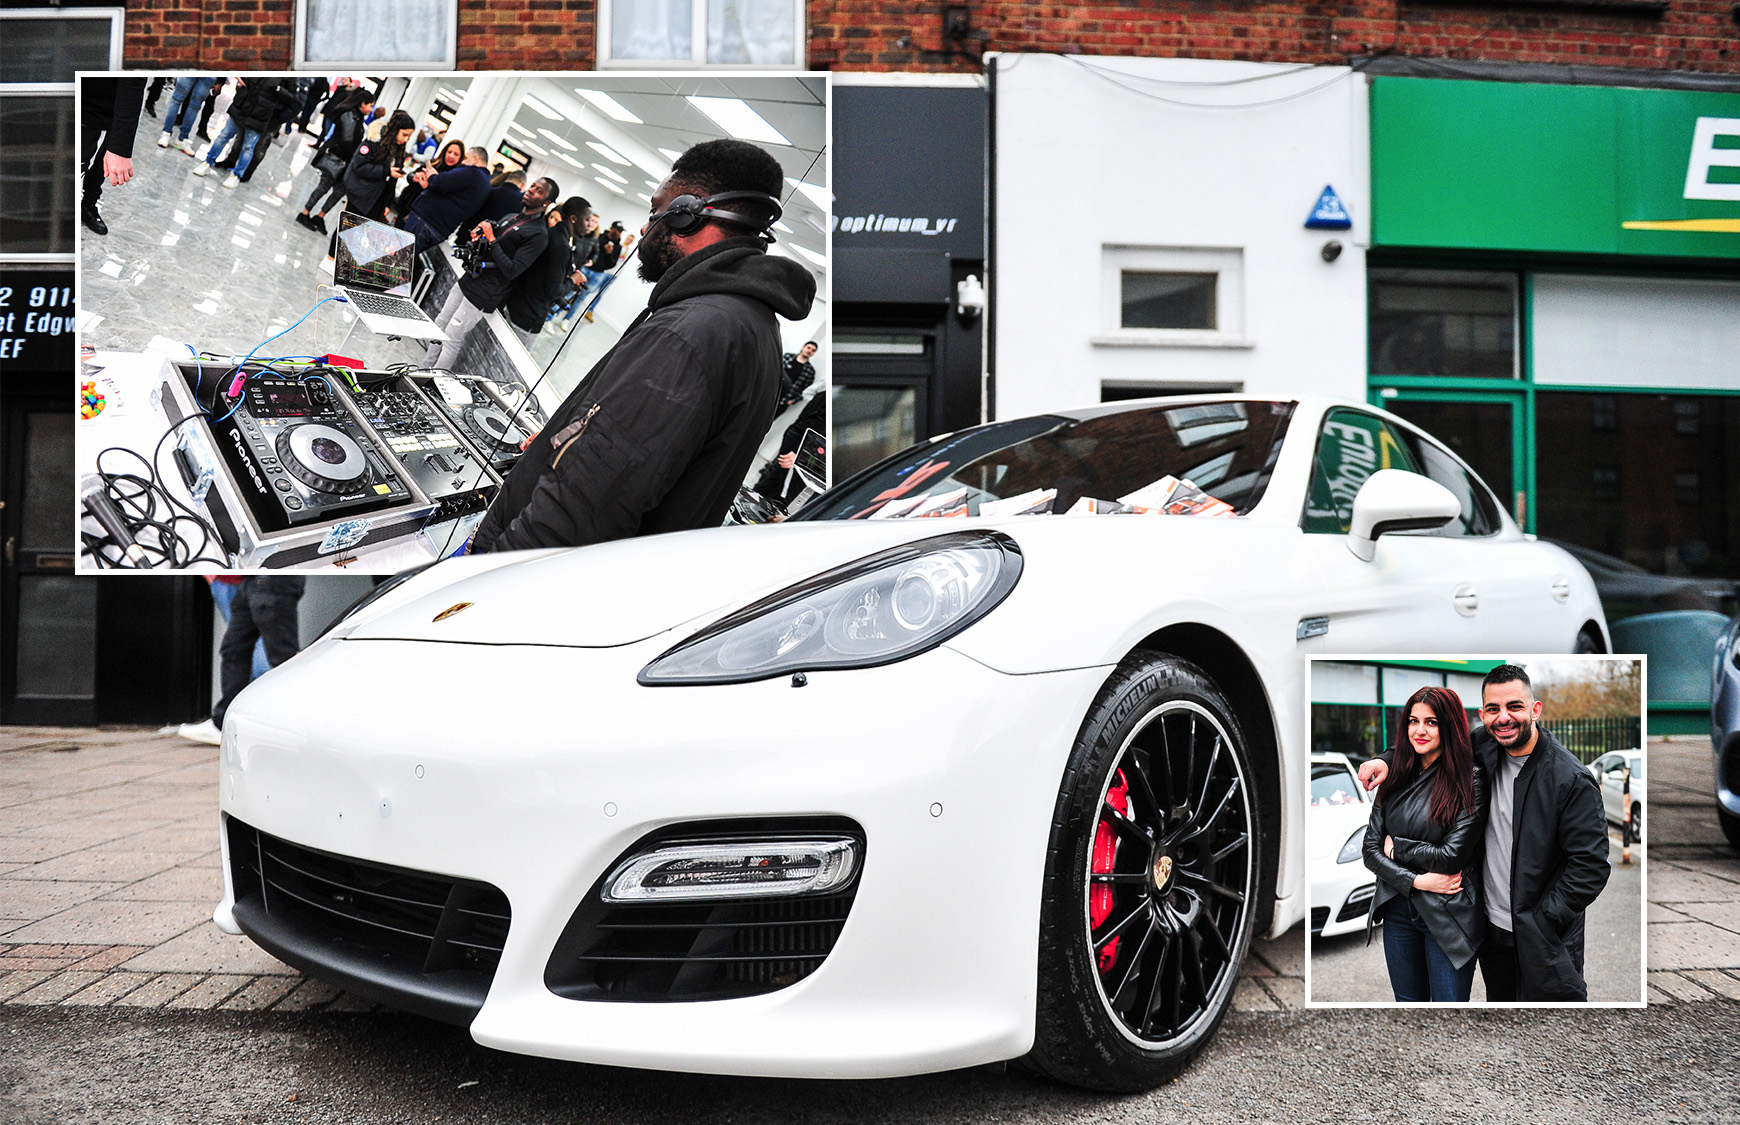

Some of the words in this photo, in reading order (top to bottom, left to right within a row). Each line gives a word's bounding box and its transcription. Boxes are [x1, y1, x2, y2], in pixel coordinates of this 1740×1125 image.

[1682, 116, 1740, 201] E
[28, 286, 75, 307] 911
[229, 428, 268, 494] Pioneer
[1101, 674, 1161, 746] MICHELIN
